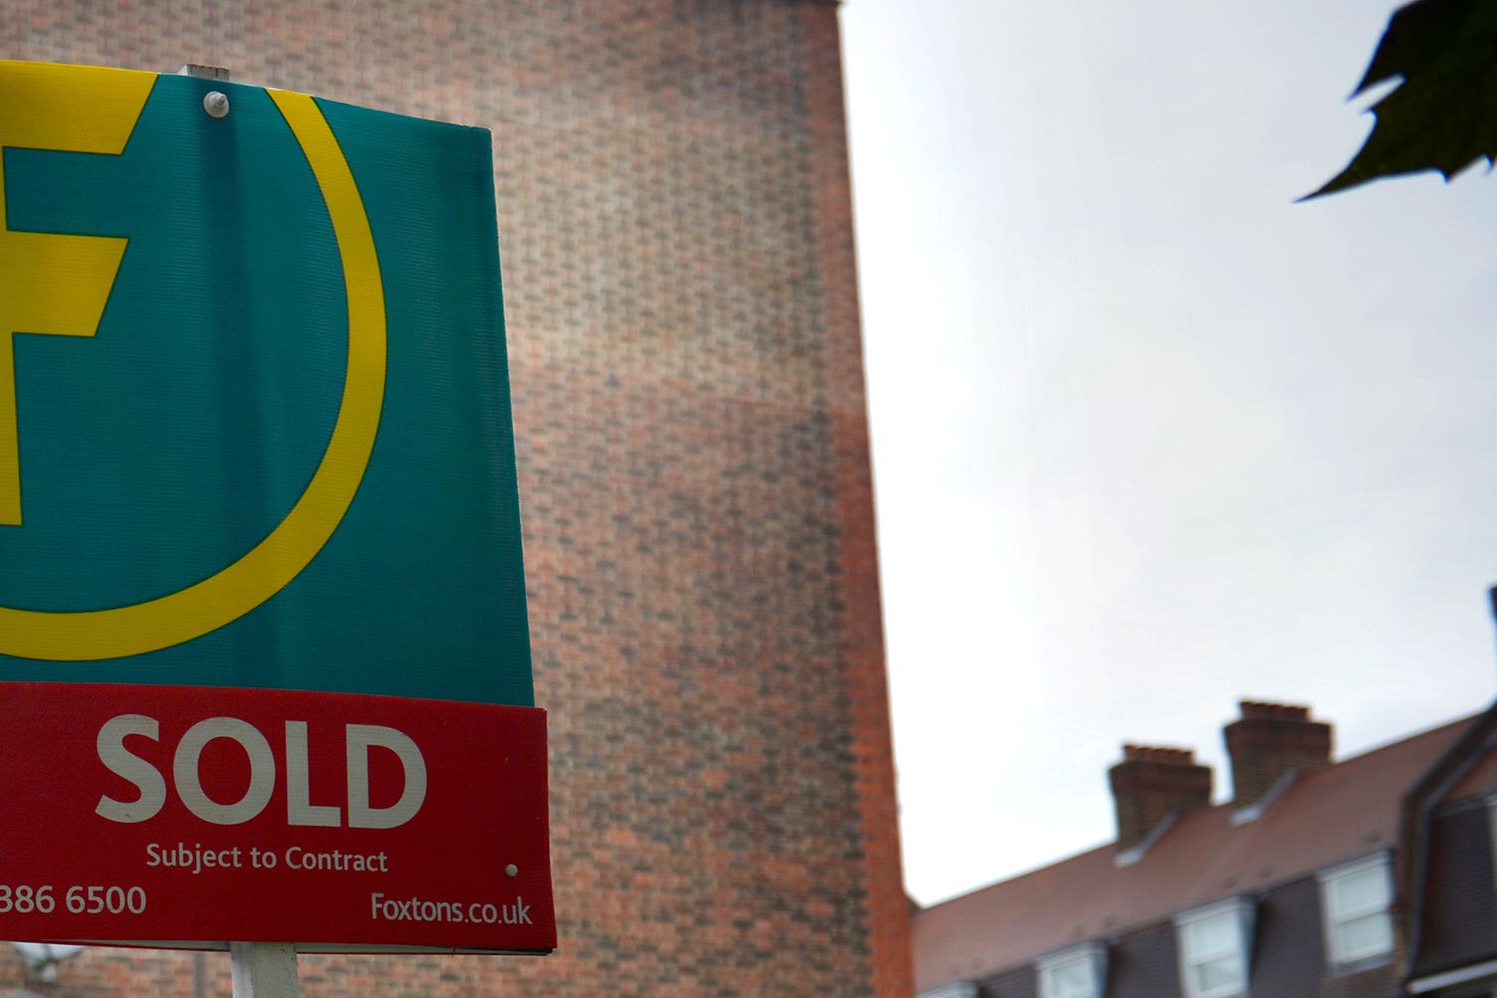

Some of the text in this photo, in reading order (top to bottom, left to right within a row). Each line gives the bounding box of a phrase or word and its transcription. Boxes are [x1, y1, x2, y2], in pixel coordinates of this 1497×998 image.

[95, 713, 427, 828] SOLD
[146, 843, 388, 874] Subject to Contract
[66, 885, 146, 914] 6500
[372, 893, 532, 926] Foxtons.co.uk
